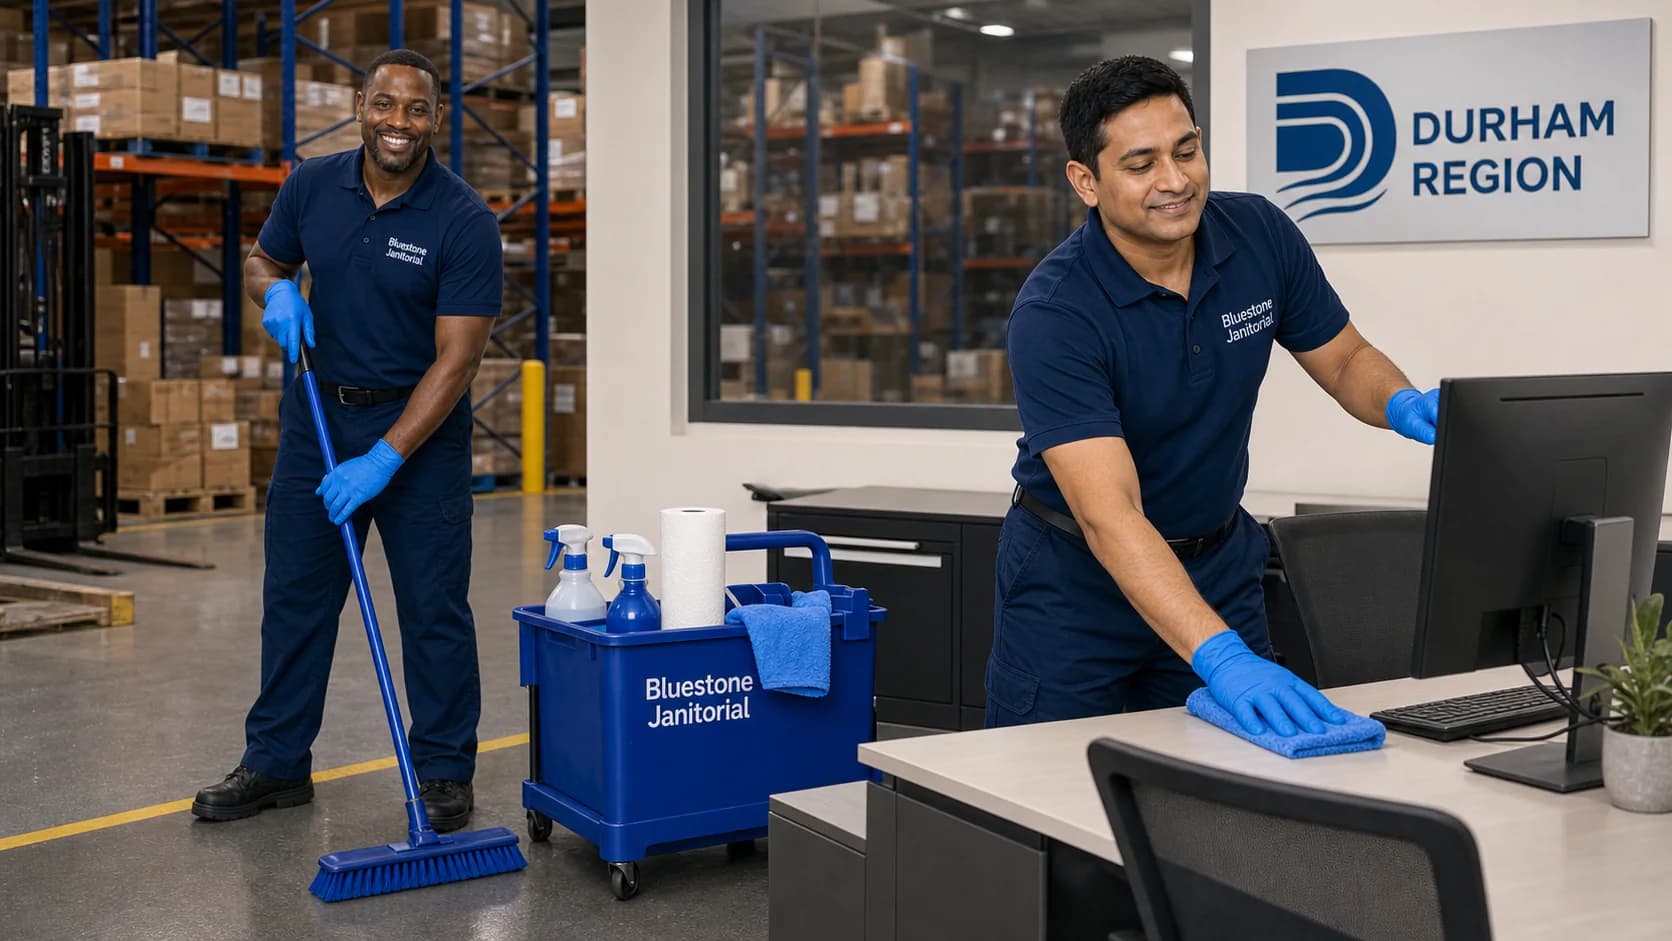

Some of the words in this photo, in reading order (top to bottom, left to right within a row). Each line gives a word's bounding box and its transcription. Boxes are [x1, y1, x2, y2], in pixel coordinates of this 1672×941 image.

[1412, 99, 1615, 146] DURHAM
[1412, 155, 1582, 197] REGION
[385, 248, 424, 266] Janitorial
[388, 236, 427, 256] Bluestone
[1221, 298, 1273, 328] Bluestone
[1226, 311, 1274, 344] Janitorial
[645, 674, 754, 701] Bluestone
[647, 695, 751, 728] Janitorial
